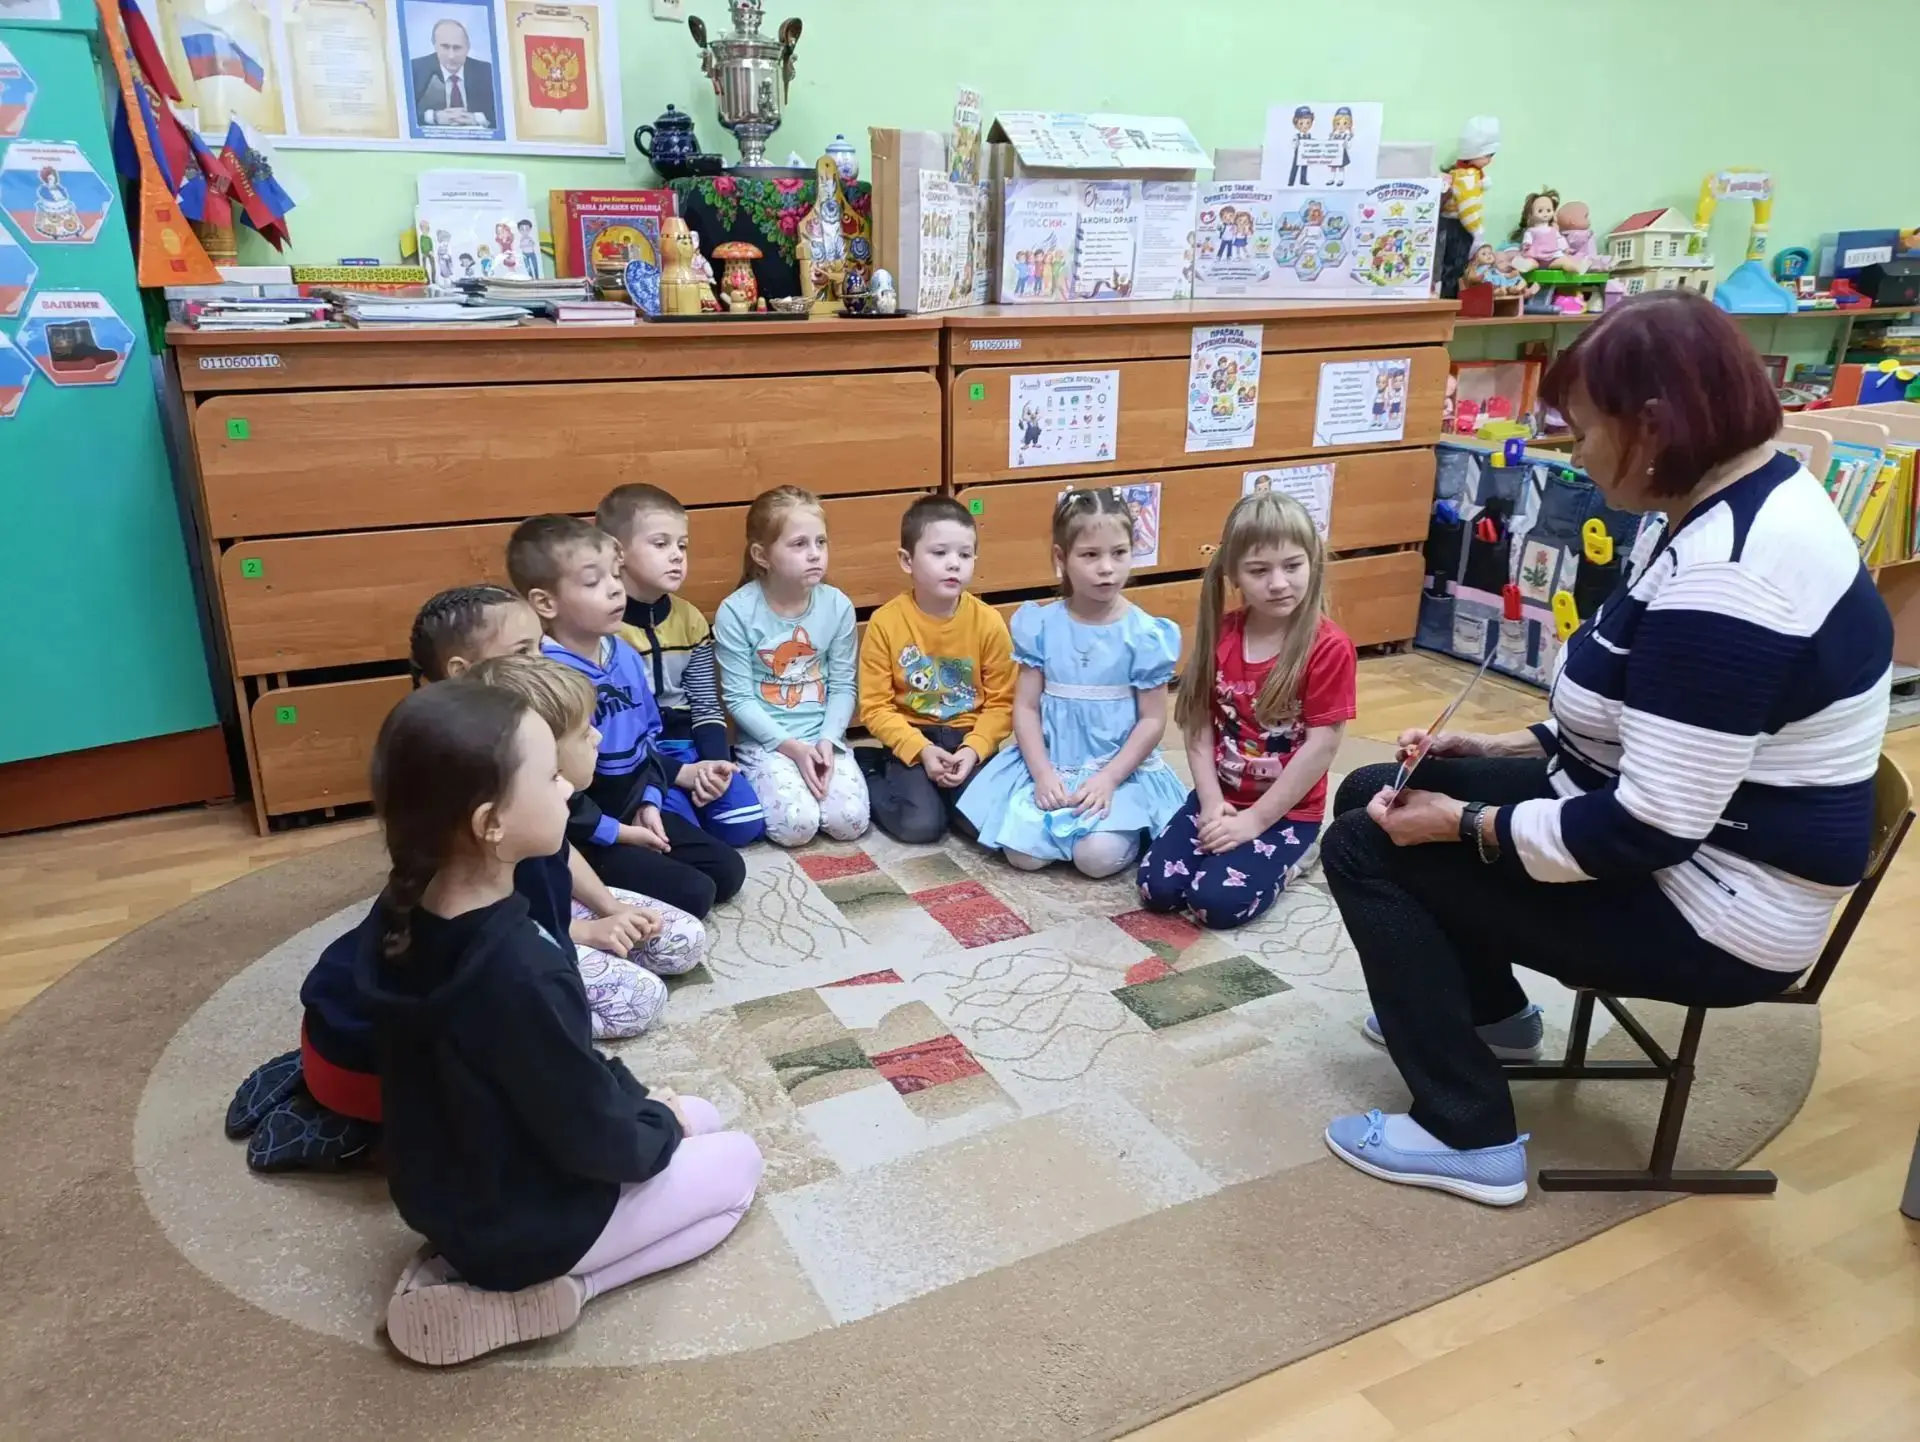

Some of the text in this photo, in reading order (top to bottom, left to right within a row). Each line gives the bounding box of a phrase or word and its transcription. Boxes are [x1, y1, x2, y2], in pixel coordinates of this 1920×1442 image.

[1376, 188, 1422, 200] ОРЛЯТА?
[1027, 201, 1059, 209] ПРОЕКТ
[41, 300, 101, 309] ВАЛЕНКИ
[200, 355, 280, 369] 0110600110
[247, 562, 256, 574] 2
[282, 709, 290, 720] 3
